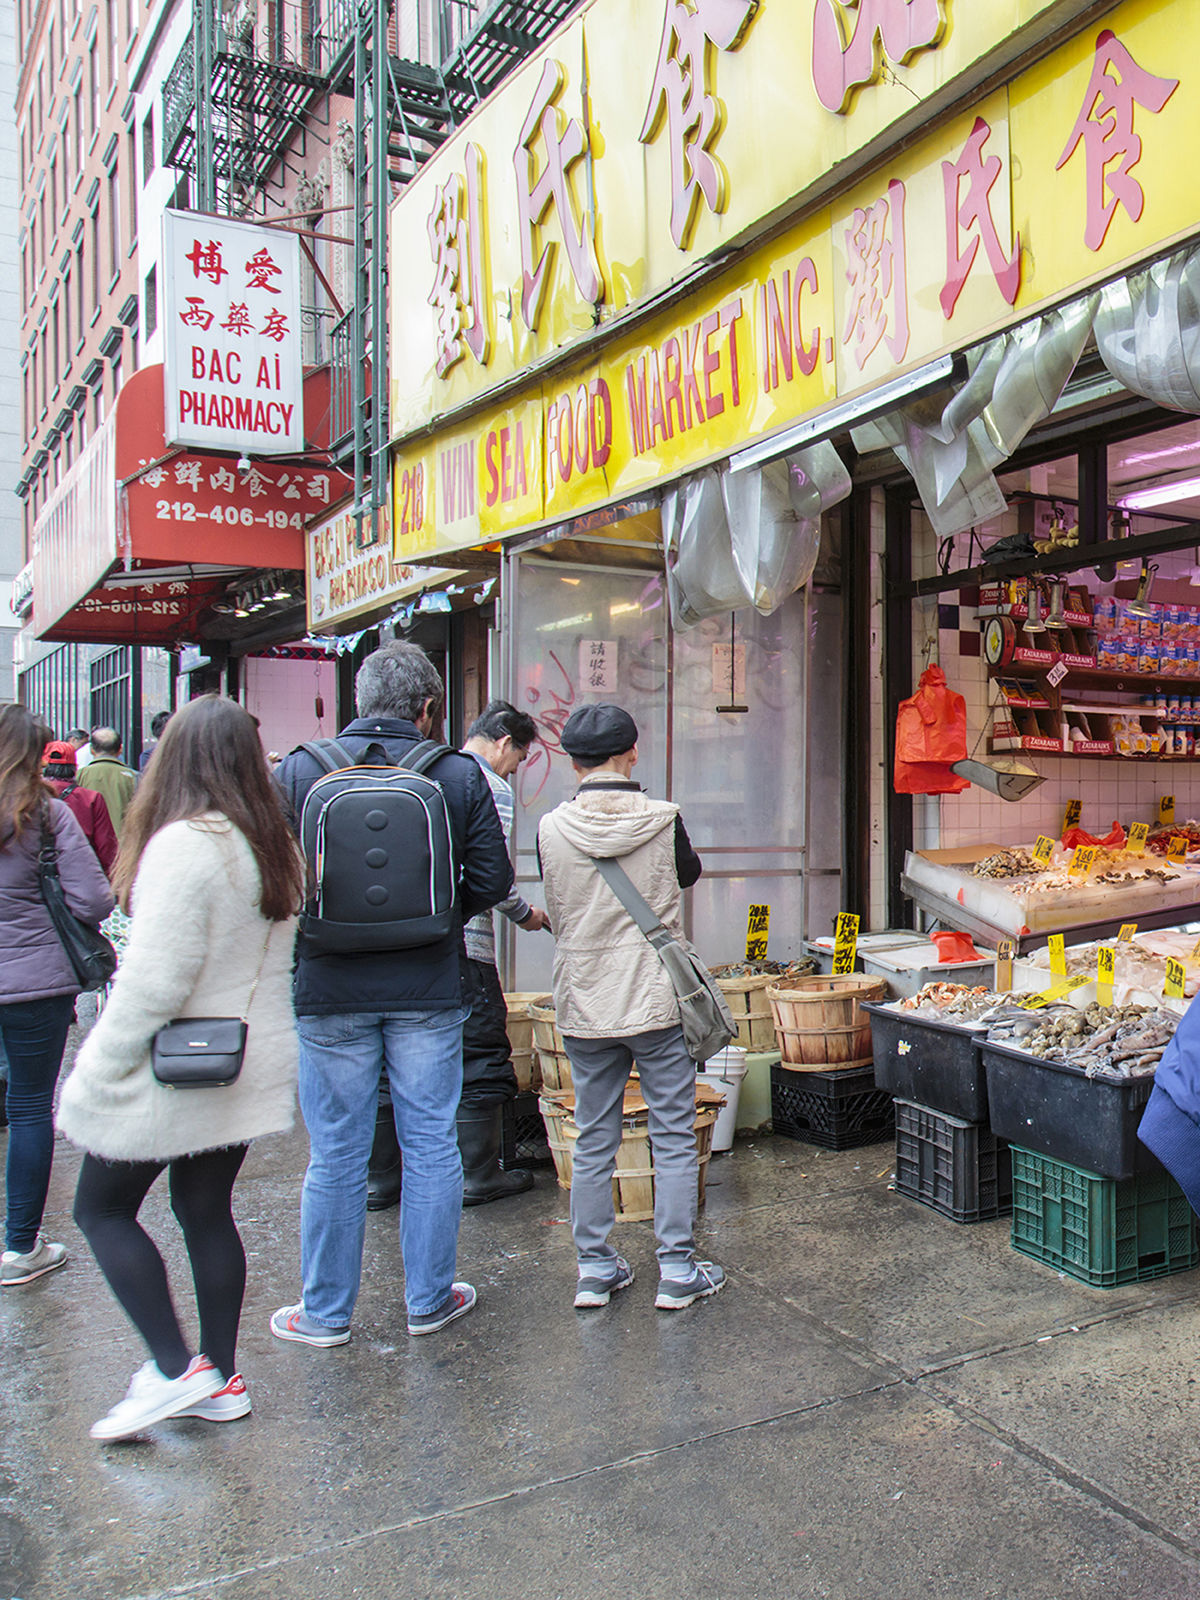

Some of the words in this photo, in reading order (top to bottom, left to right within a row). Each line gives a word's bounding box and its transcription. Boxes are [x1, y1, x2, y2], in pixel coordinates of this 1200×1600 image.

[185, 239, 282, 294] 博愛
[179, 297, 290, 342] 西藥房
[191, 345, 241, 385] BAC
[179, 389, 294, 436] PHARMACY
[401, 461, 424, 536] 218
[440, 440, 476, 524] WIN
[485, 421, 528, 508] SEA
[547, 377, 613, 490] FOOD
[626, 297, 744, 457] MARKET
[760, 256, 834, 393] INC.
